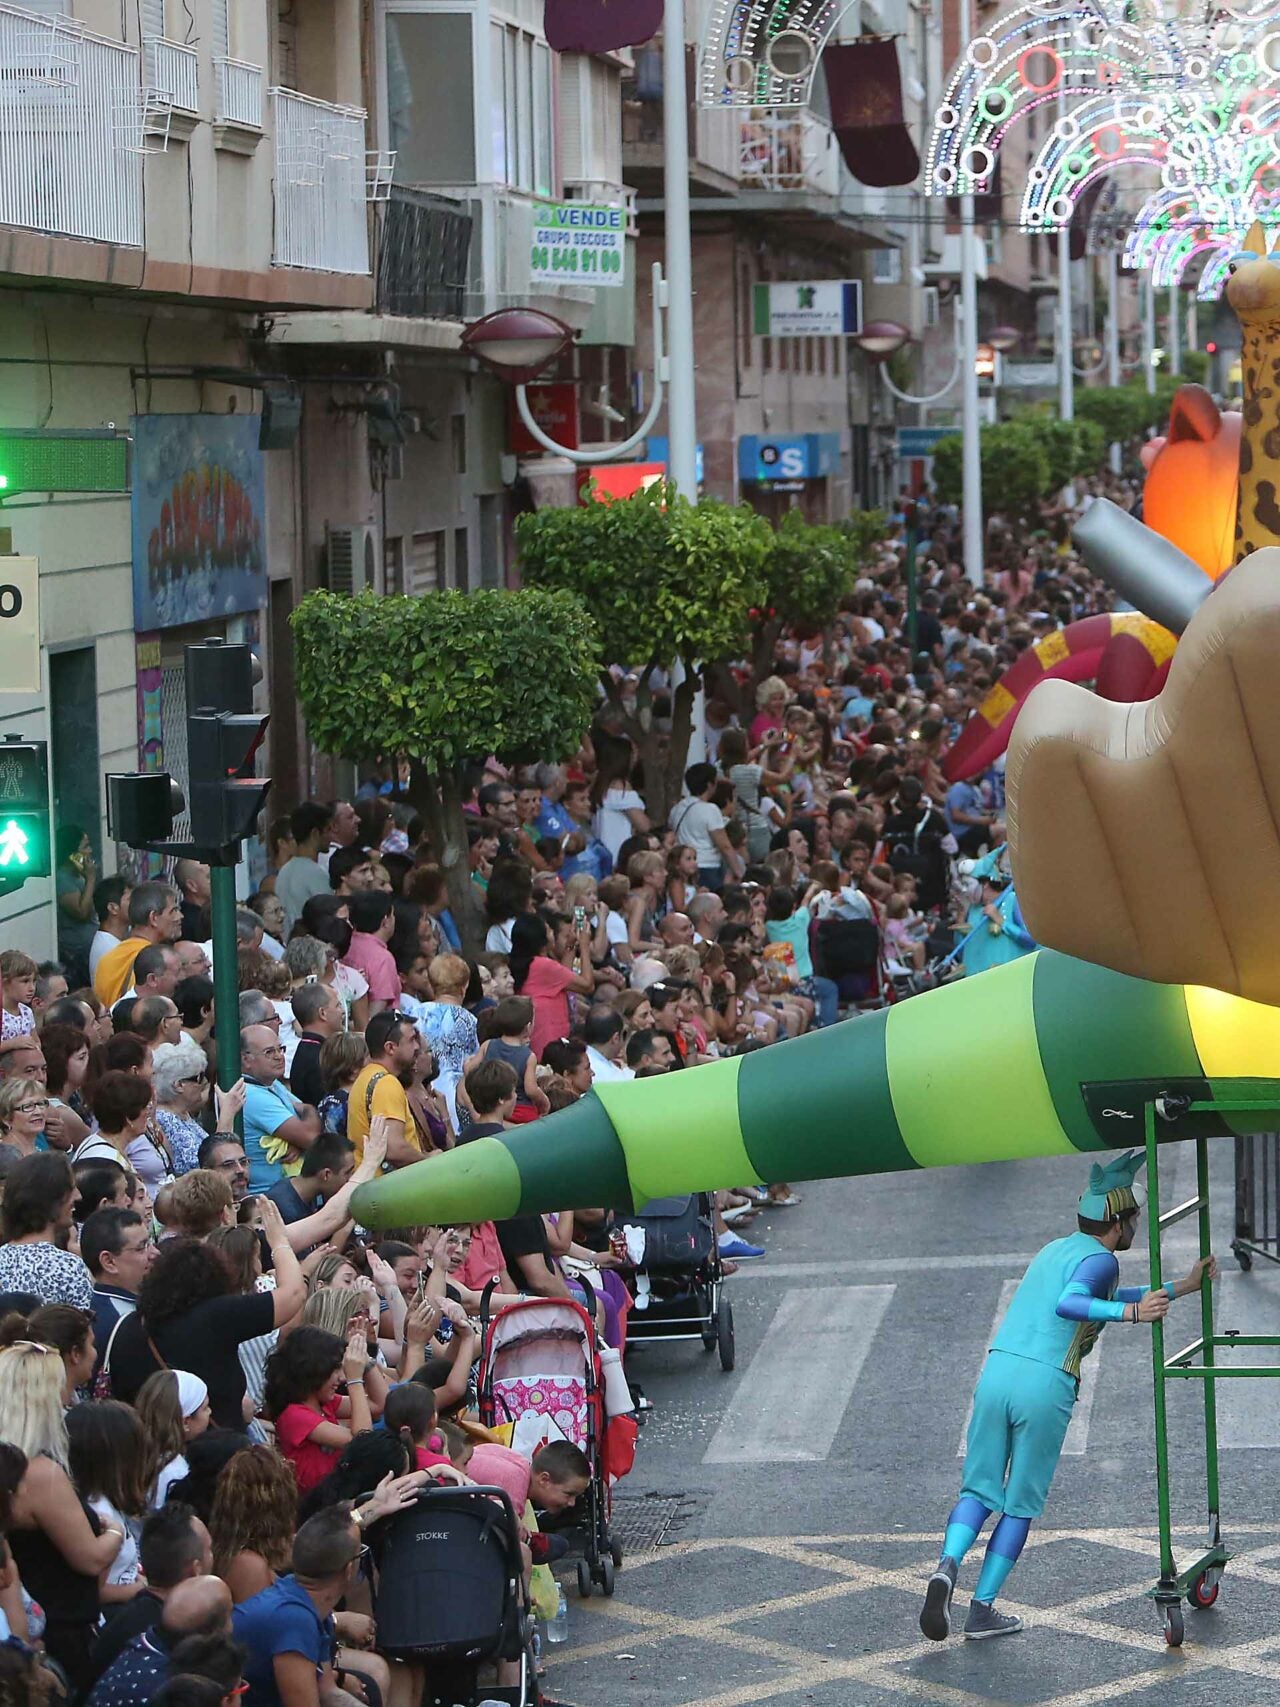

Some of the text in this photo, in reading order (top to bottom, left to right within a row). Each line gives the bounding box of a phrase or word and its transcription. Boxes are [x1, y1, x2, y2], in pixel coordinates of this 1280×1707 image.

[557, 209, 621, 227] VENDE
[537, 230, 570, 245] GRUPO
[416, 1532, 450, 1541] STOKKE
